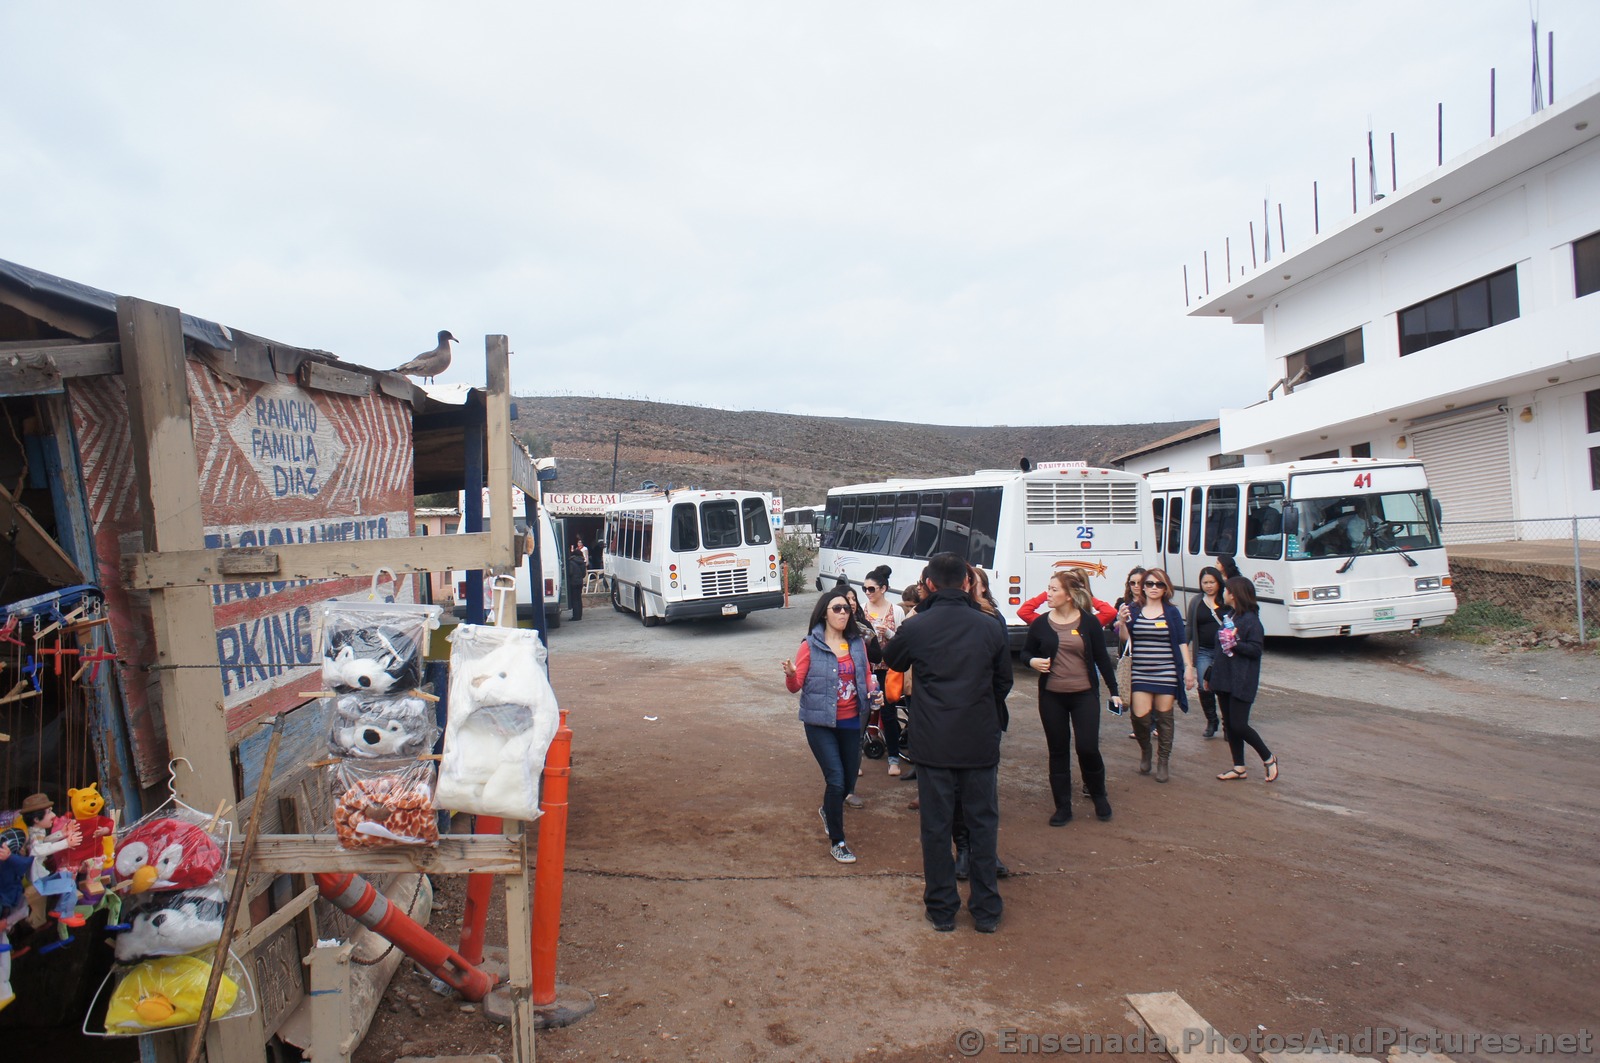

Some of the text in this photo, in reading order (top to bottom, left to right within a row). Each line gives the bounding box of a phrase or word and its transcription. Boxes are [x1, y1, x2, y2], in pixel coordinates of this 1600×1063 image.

[255, 395, 317, 433] RANCHO
[252, 428, 319, 466] FAMILIA
[273, 465, 319, 497] DIAZ
[1353, 472, 1371, 489] 41
[549, 494, 569, 504] ICE
[572, 494, 617, 504] CREAM
[1076, 526, 1094, 539] 25
[215, 605, 314, 697] RKING
